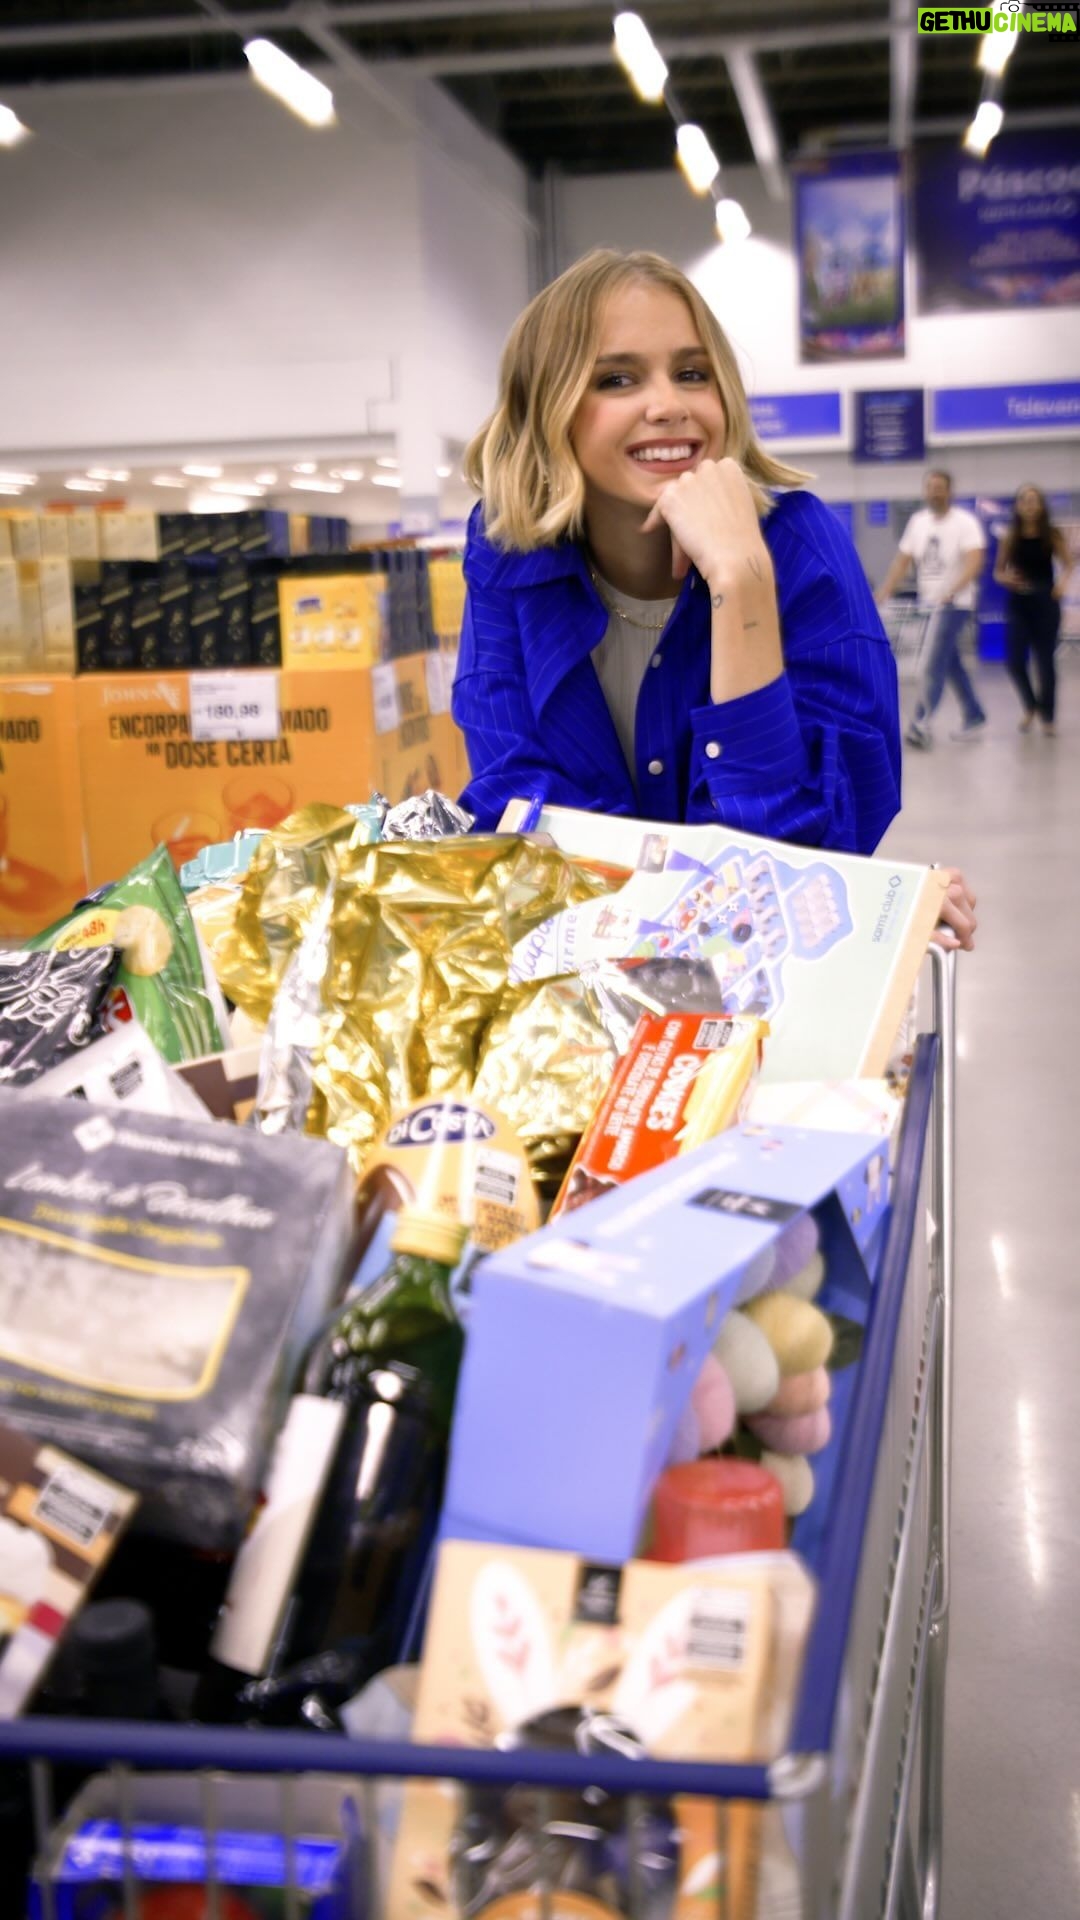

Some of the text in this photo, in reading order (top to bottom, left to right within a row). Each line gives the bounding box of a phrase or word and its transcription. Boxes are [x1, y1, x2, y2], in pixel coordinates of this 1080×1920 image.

[164, 740, 219, 769] DOSE
[226, 736, 291, 768] CERTA
[645, 1054, 701, 1132] COOKIES
